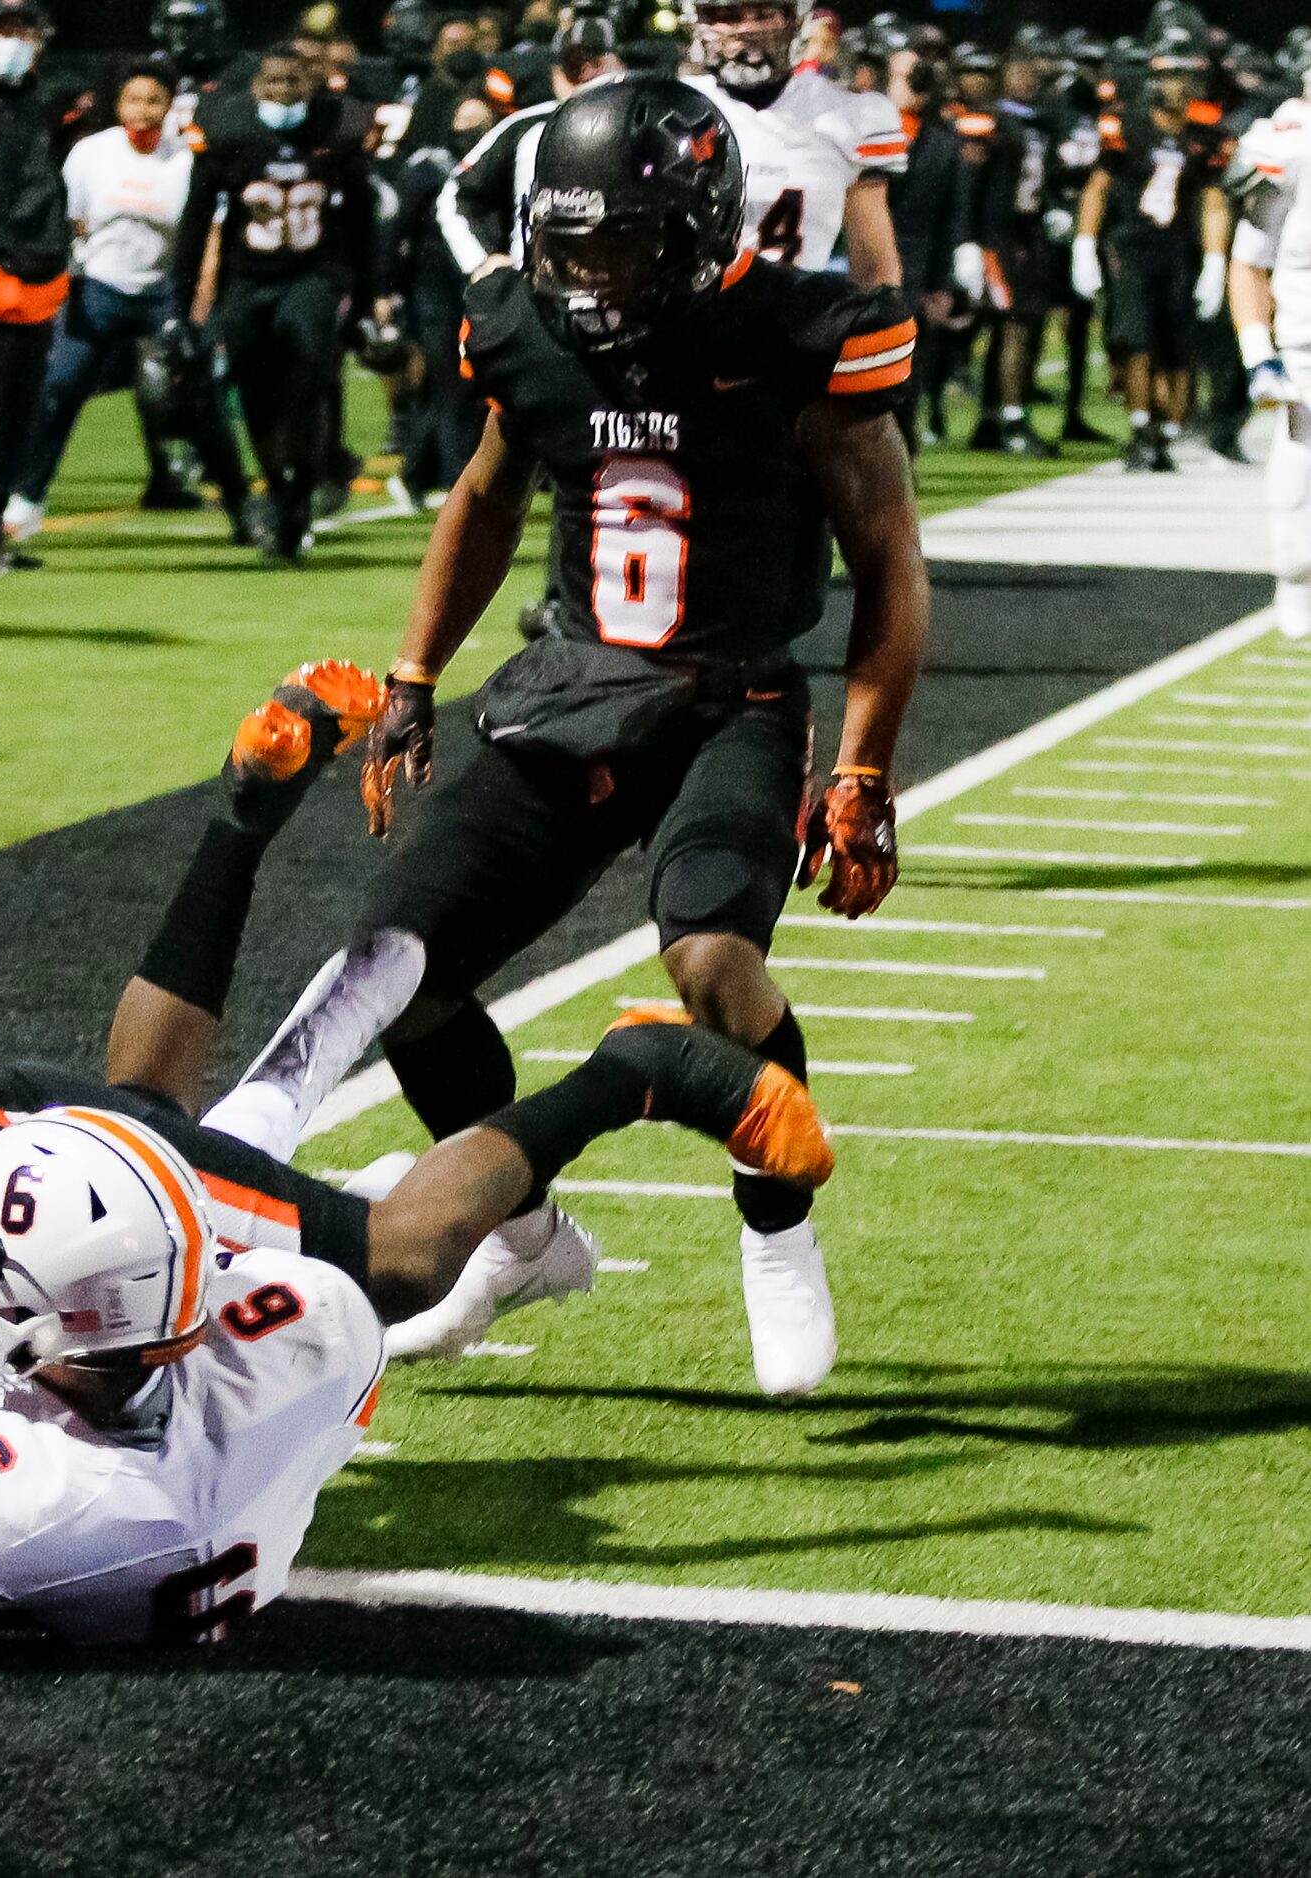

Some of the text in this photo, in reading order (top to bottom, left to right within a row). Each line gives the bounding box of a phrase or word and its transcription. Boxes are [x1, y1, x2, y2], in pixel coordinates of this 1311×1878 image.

[590, 410, 679, 450] TIGERS
[592, 453, 690, 648] 6
[0, 1163, 44, 1236] 6
